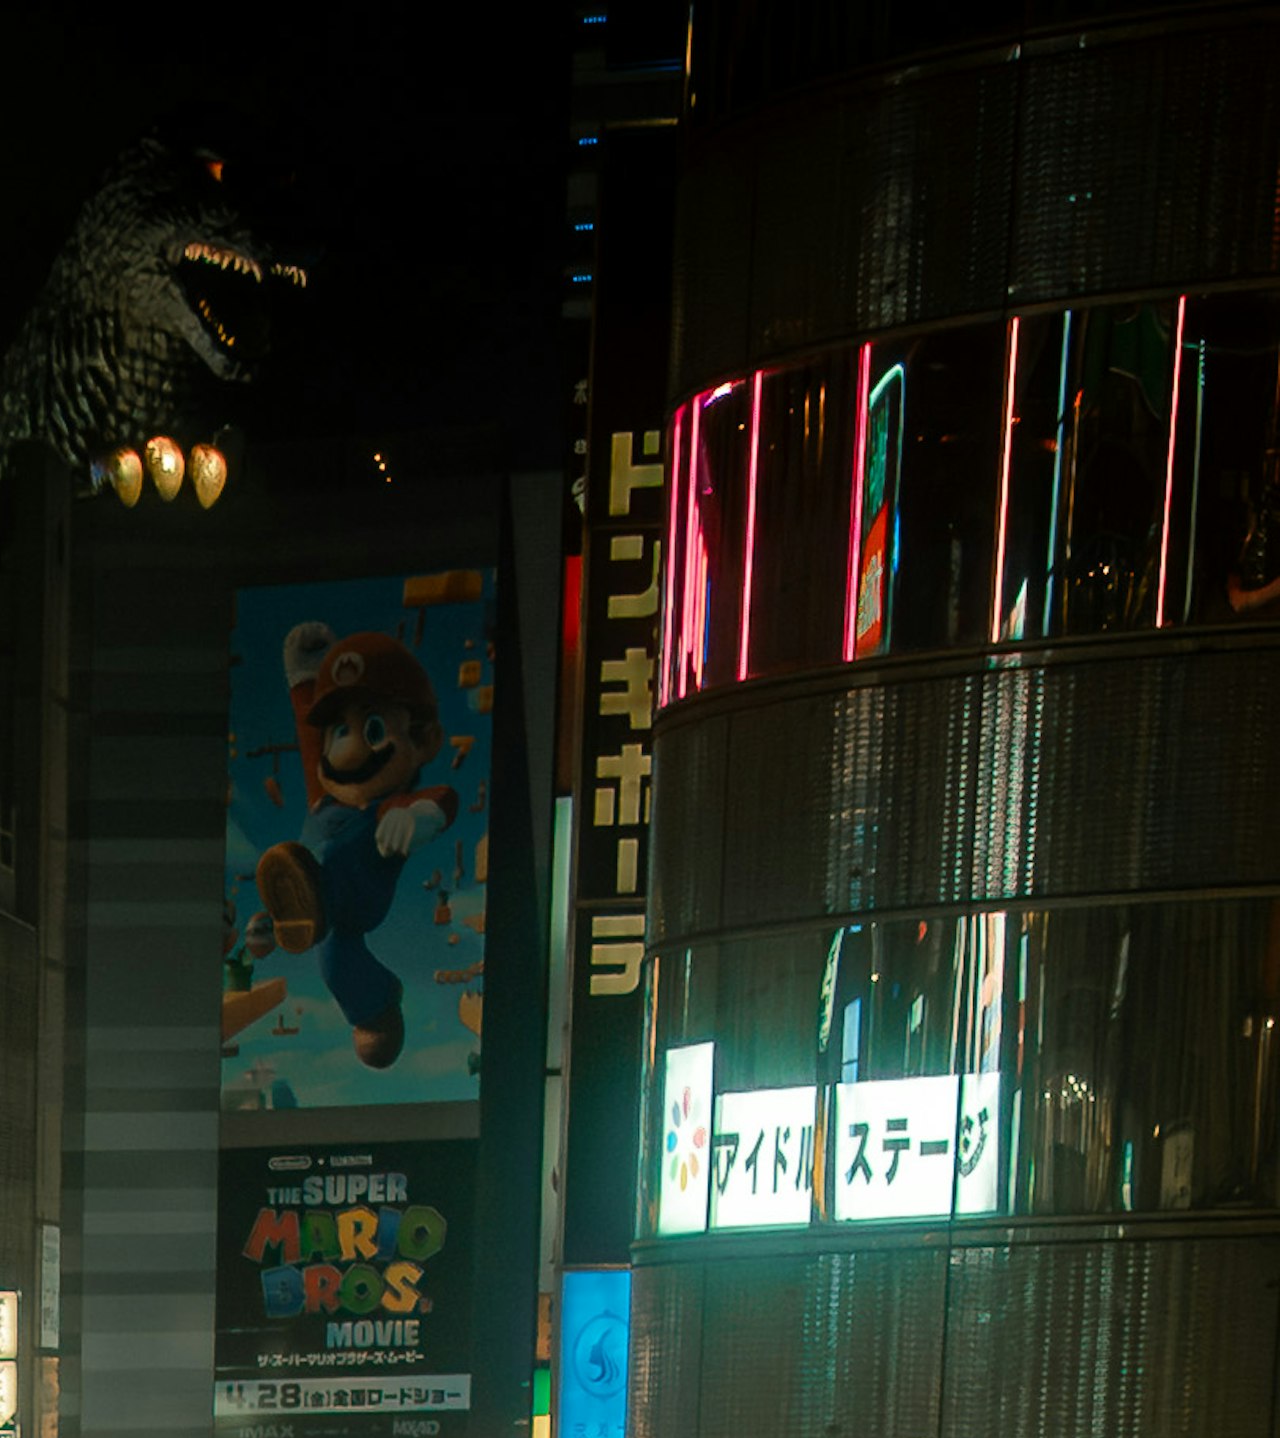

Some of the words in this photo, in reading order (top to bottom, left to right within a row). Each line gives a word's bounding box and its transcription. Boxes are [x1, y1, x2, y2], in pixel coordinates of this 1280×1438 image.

[713, 1106, 989, 1197] アイドルステージ
[269, 1187, 302, 1205] THE
[303, 1173, 407, 1205] SUPER
[243, 1205, 447, 1263] MARIO
[260, 1262, 433, 1318] BROS.
[326, 1320, 420, 1348] MOVIE
